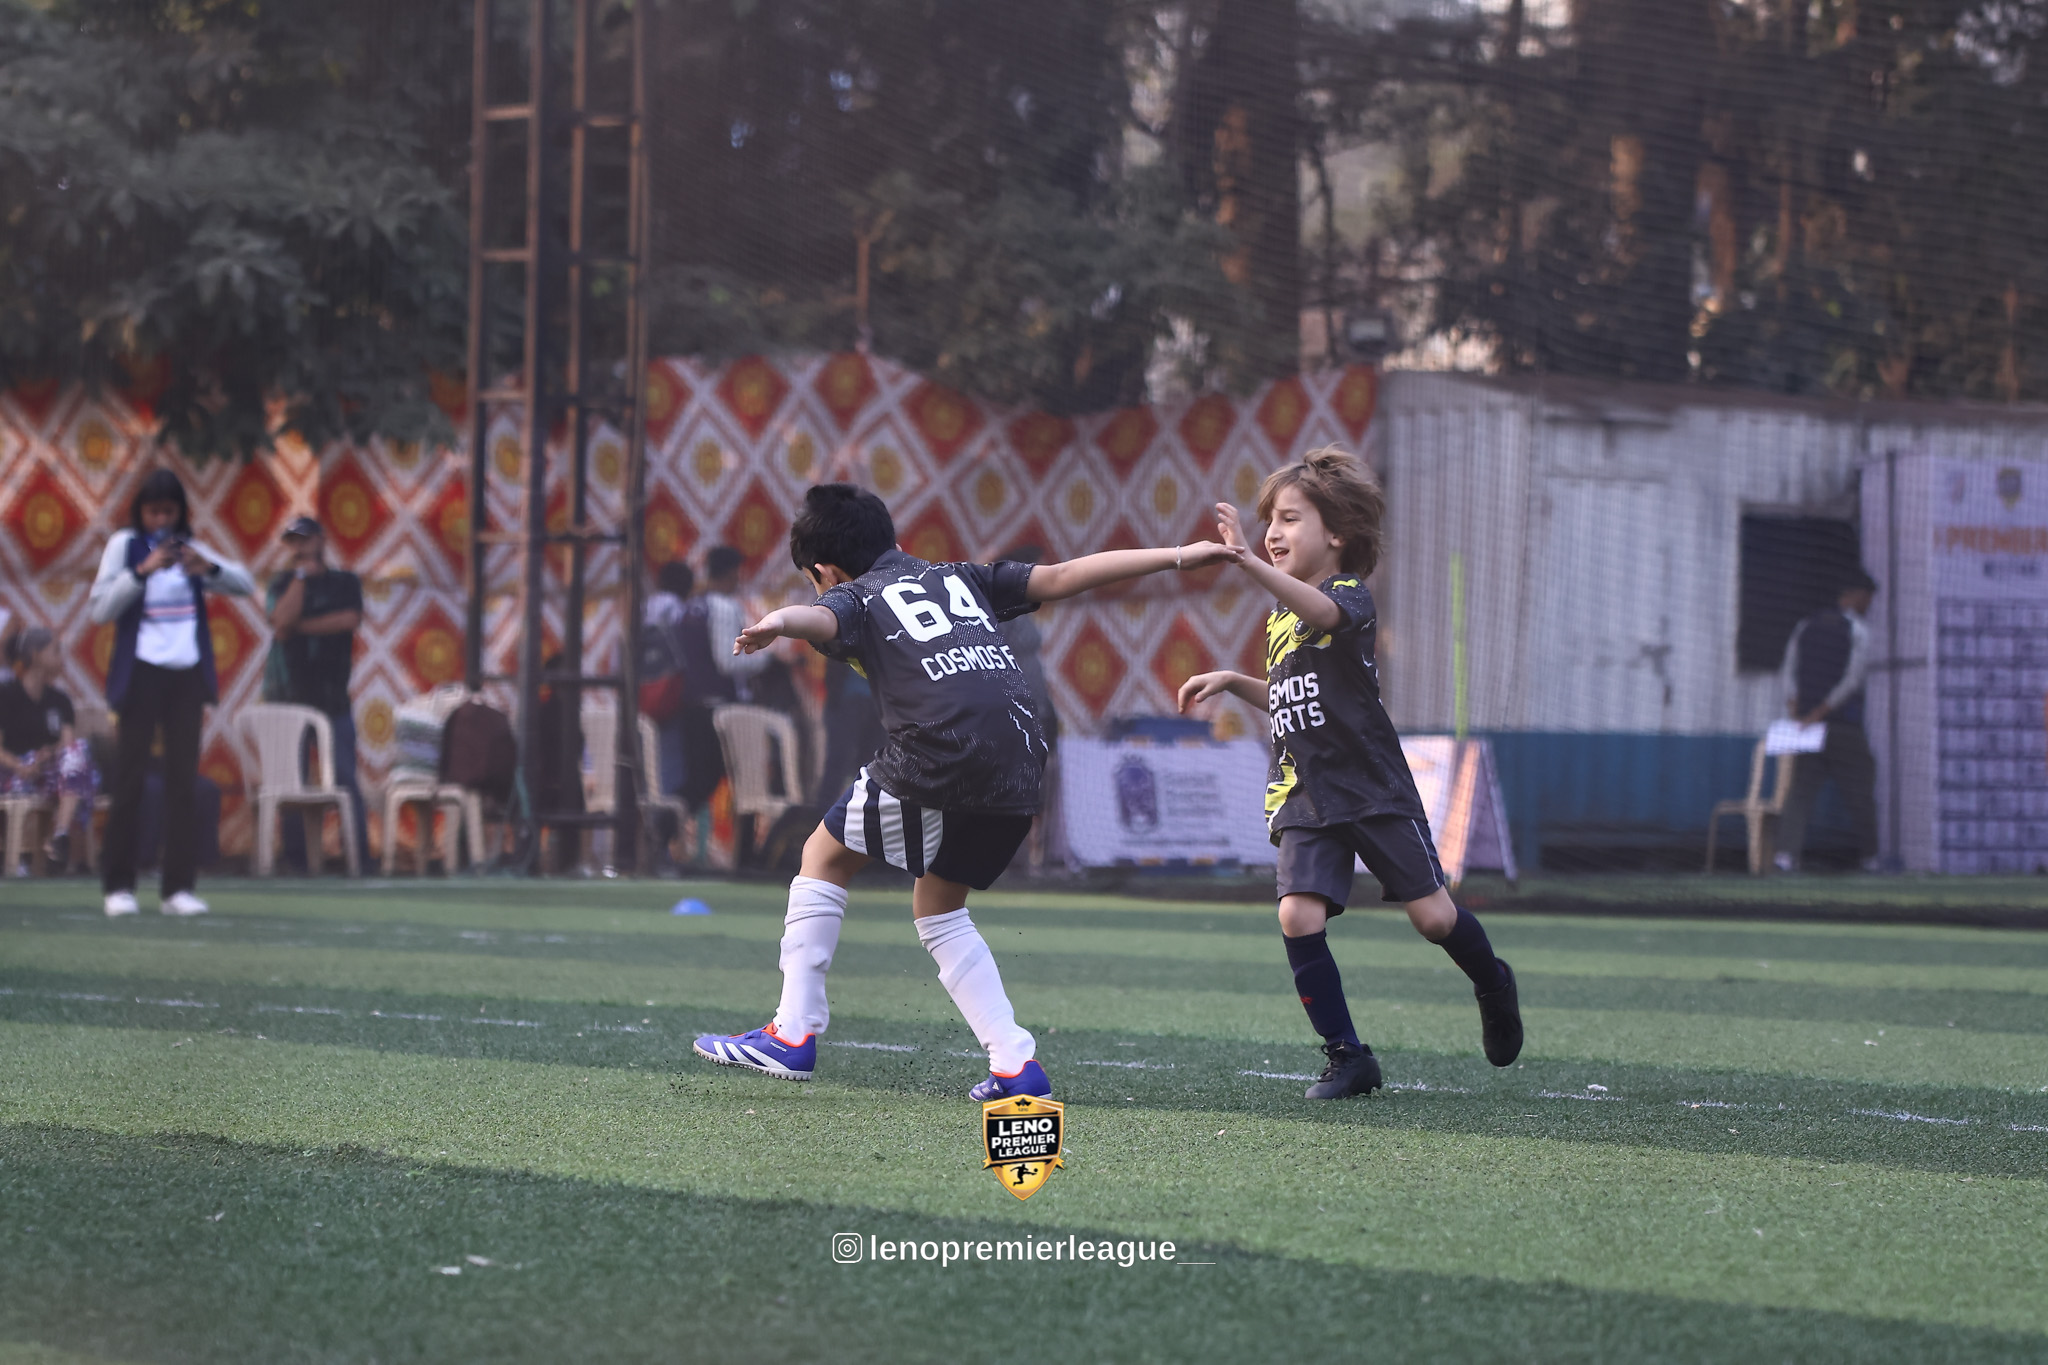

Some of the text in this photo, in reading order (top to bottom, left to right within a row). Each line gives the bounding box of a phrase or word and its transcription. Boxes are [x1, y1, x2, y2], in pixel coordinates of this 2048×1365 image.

[881, 574, 996, 642] 64
[920, 644, 1006, 682] COSMOS
[1269, 672, 1320, 713] SMOS
